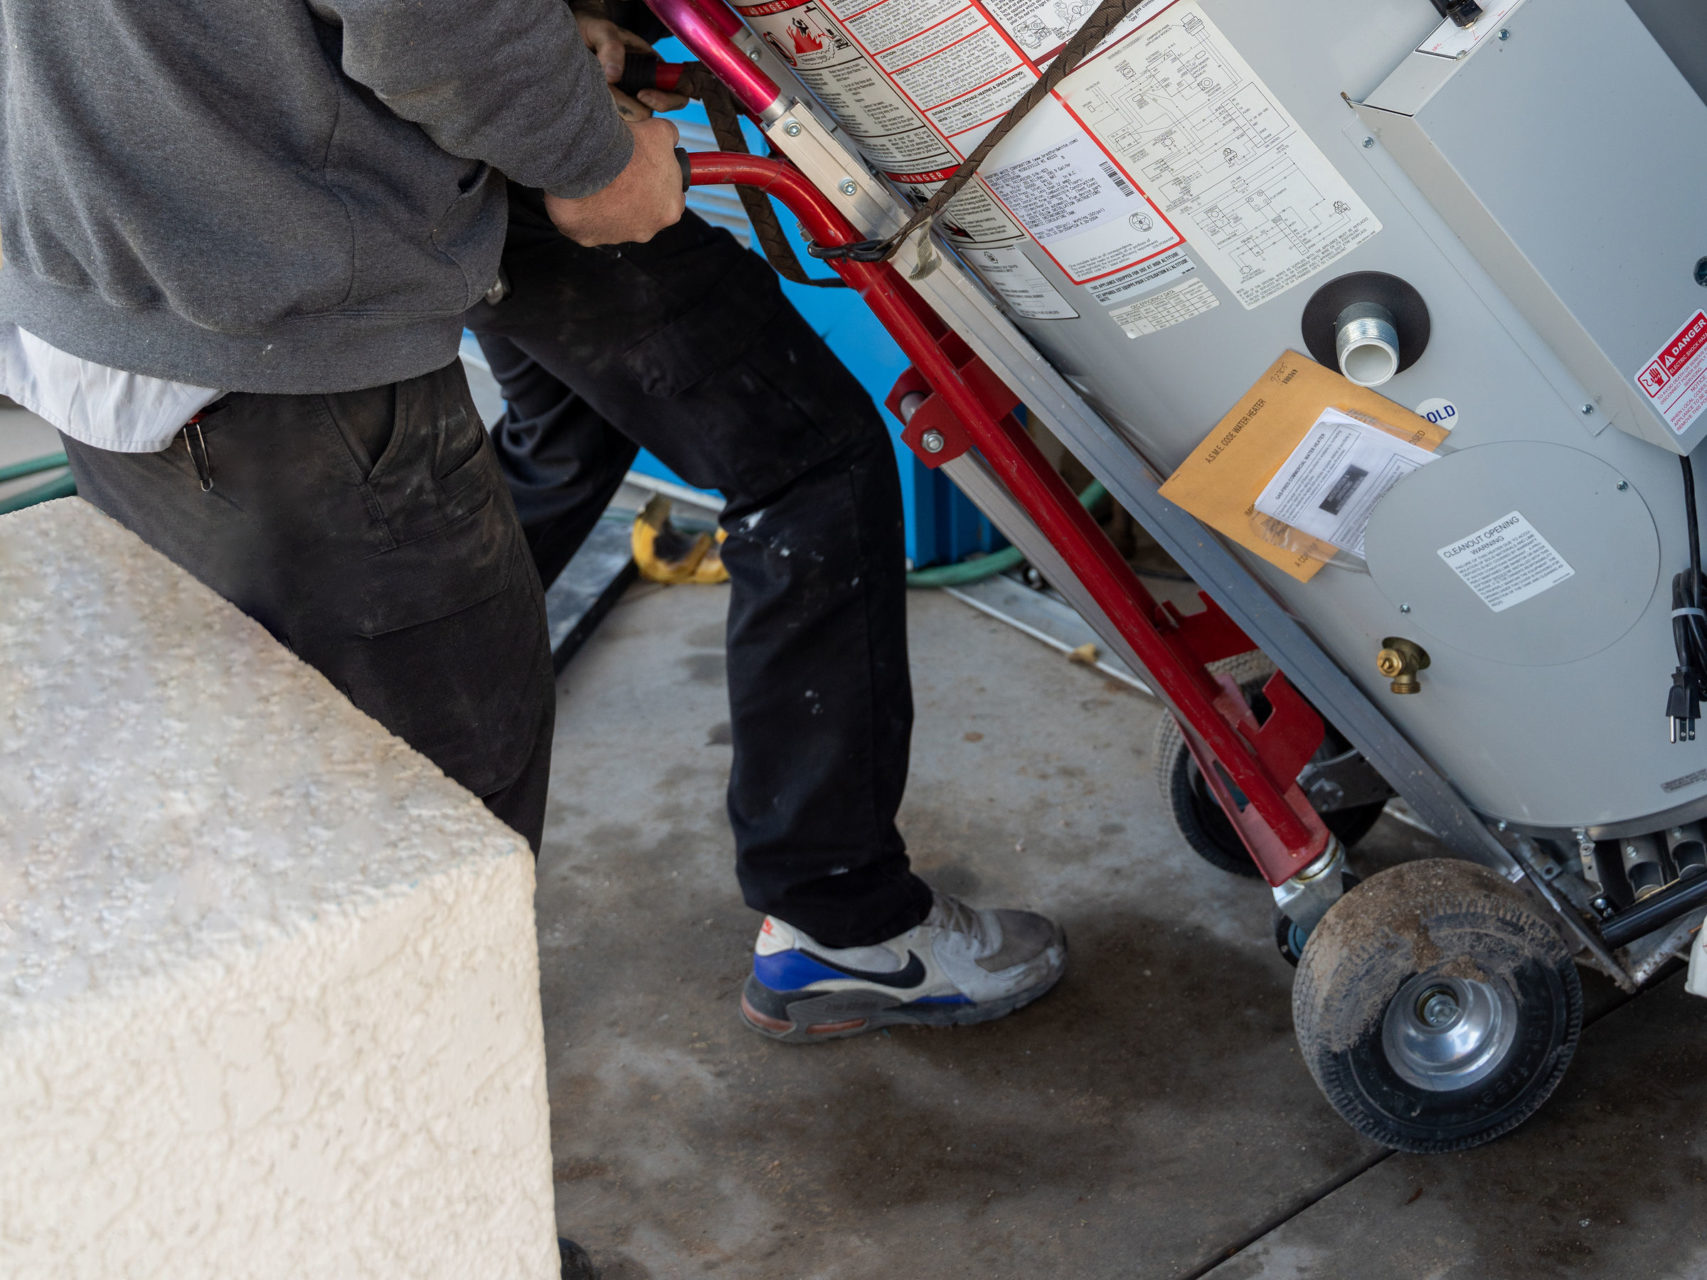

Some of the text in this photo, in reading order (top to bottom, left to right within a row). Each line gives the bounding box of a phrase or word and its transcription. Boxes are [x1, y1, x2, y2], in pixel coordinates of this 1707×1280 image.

[905, 171, 944, 182] DANGER
[1099, 279, 1116, 288] APPLIANCE
[1116, 273, 1132, 282] EQUIPPED
[1161, 252, 1179, 263] ALTITUDE
[1671, 319, 1706, 356] DANGER
[1669, 354, 1687, 374] ELECTRIC
[1685, 342, 1700, 356] SHOCK
[1659, 382, 1682, 405] DISCONNECT
[1681, 369, 1694, 383] POWER
[1663, 383, 1674, 395] AVOID
[1672, 372, 1685, 384] DEATH
[1221, 431, 1236, 447] CODE
[1232, 416, 1250, 434] WATER
[1246, 397, 1267, 419] HEATER
[1421, 405, 1455, 424] OLD
[1670, 410, 1683, 422] WHEN
[1674, 406, 1694, 427] APPLIANCE
[1288, 460, 1306, 482] COMMERCIAL
[1304, 447, 1316, 461] WATER
[1313, 433, 1326, 448] HEATER
[1443, 515, 1520, 559] CLEANOUT OPENING
[1470, 535, 1505, 556] WARNING
